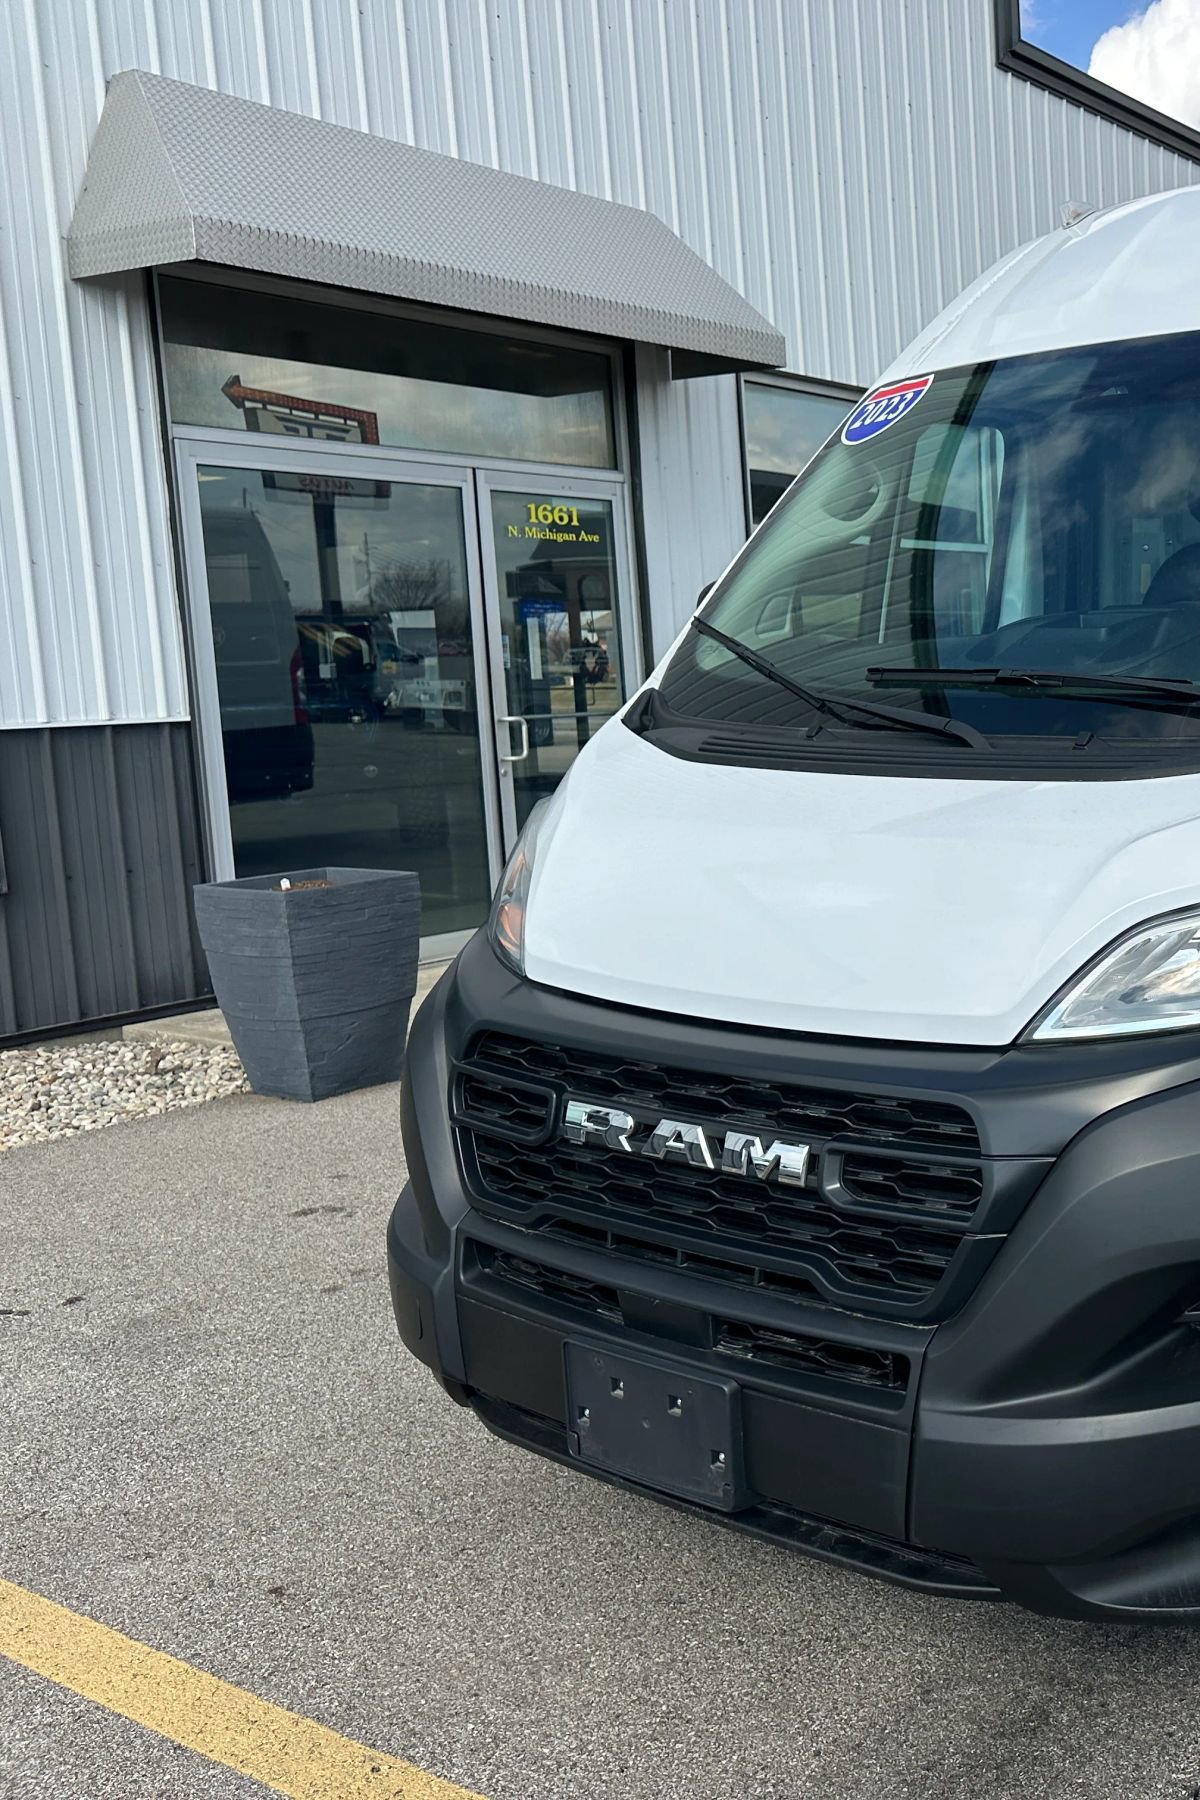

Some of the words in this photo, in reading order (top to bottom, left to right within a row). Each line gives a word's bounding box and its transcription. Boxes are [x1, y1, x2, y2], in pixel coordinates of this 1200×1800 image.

[848, 391, 914, 430] 2023
[527, 503, 580, 526] 1661
[507, 525, 522, 538] N.
[524, 527, 576, 542] Michigan
[578, 530, 600, 543] Ave
[564, 1100, 810, 1188] RAM
